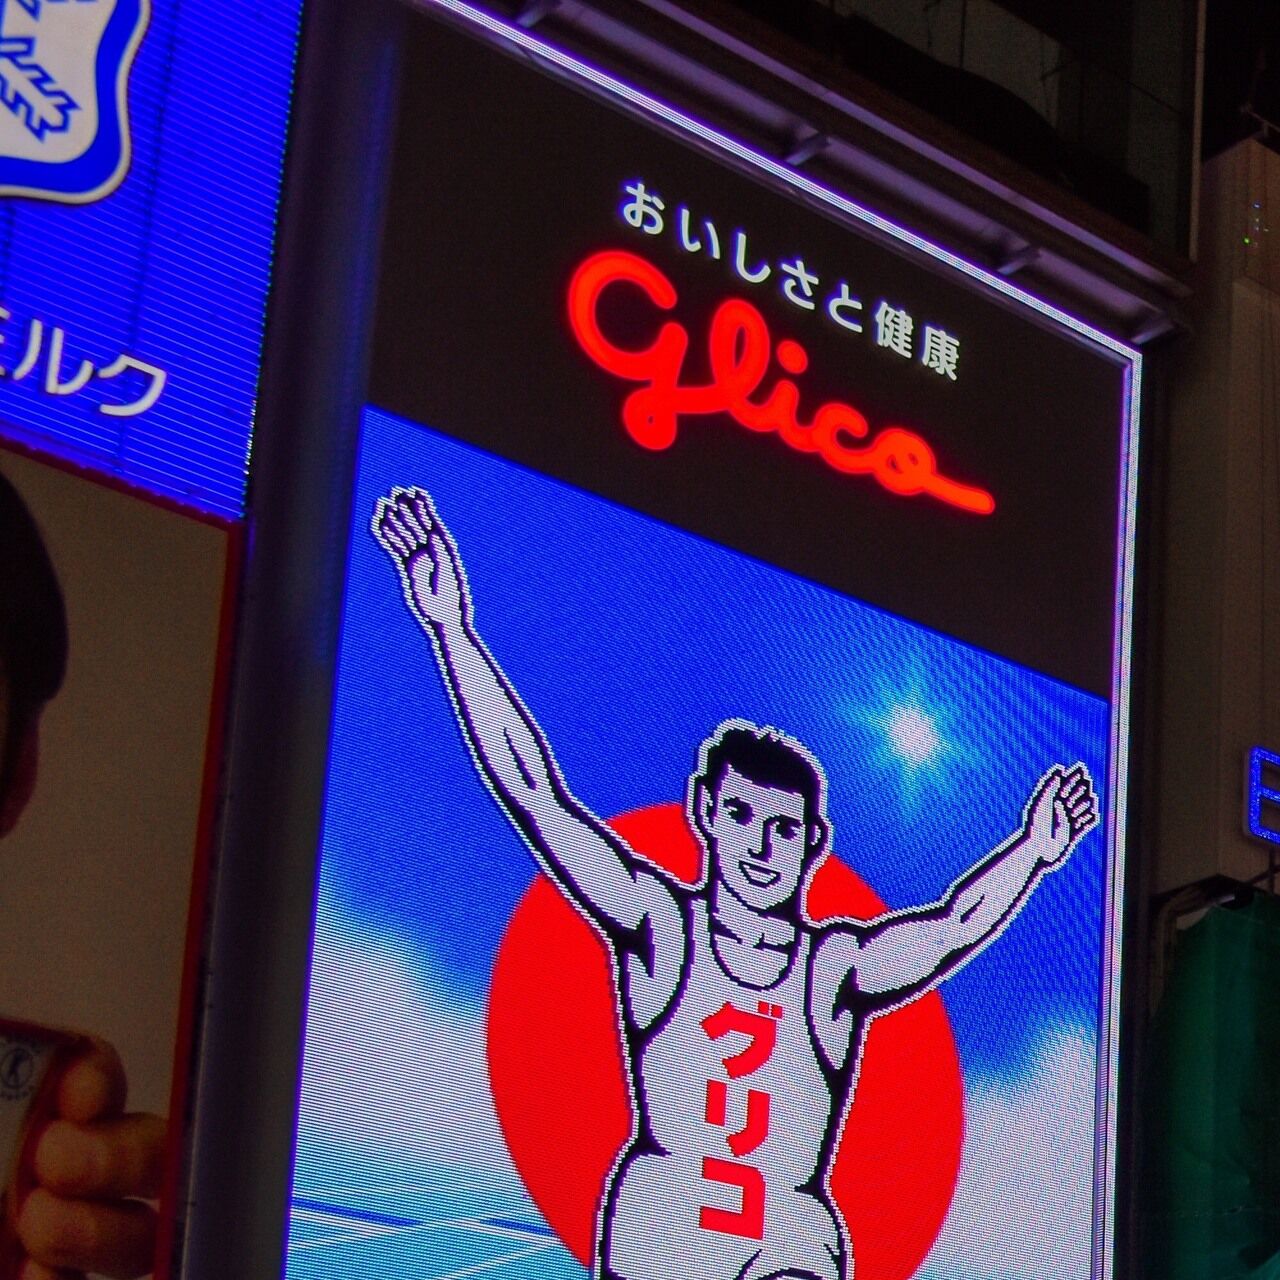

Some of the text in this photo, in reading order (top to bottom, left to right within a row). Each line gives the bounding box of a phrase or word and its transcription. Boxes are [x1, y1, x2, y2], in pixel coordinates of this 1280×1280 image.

[566, 248, 996, 515] Glico
[620, 181, 961, 383] おいしさと健康
[699, 1000, 783, 1241] グリコ
